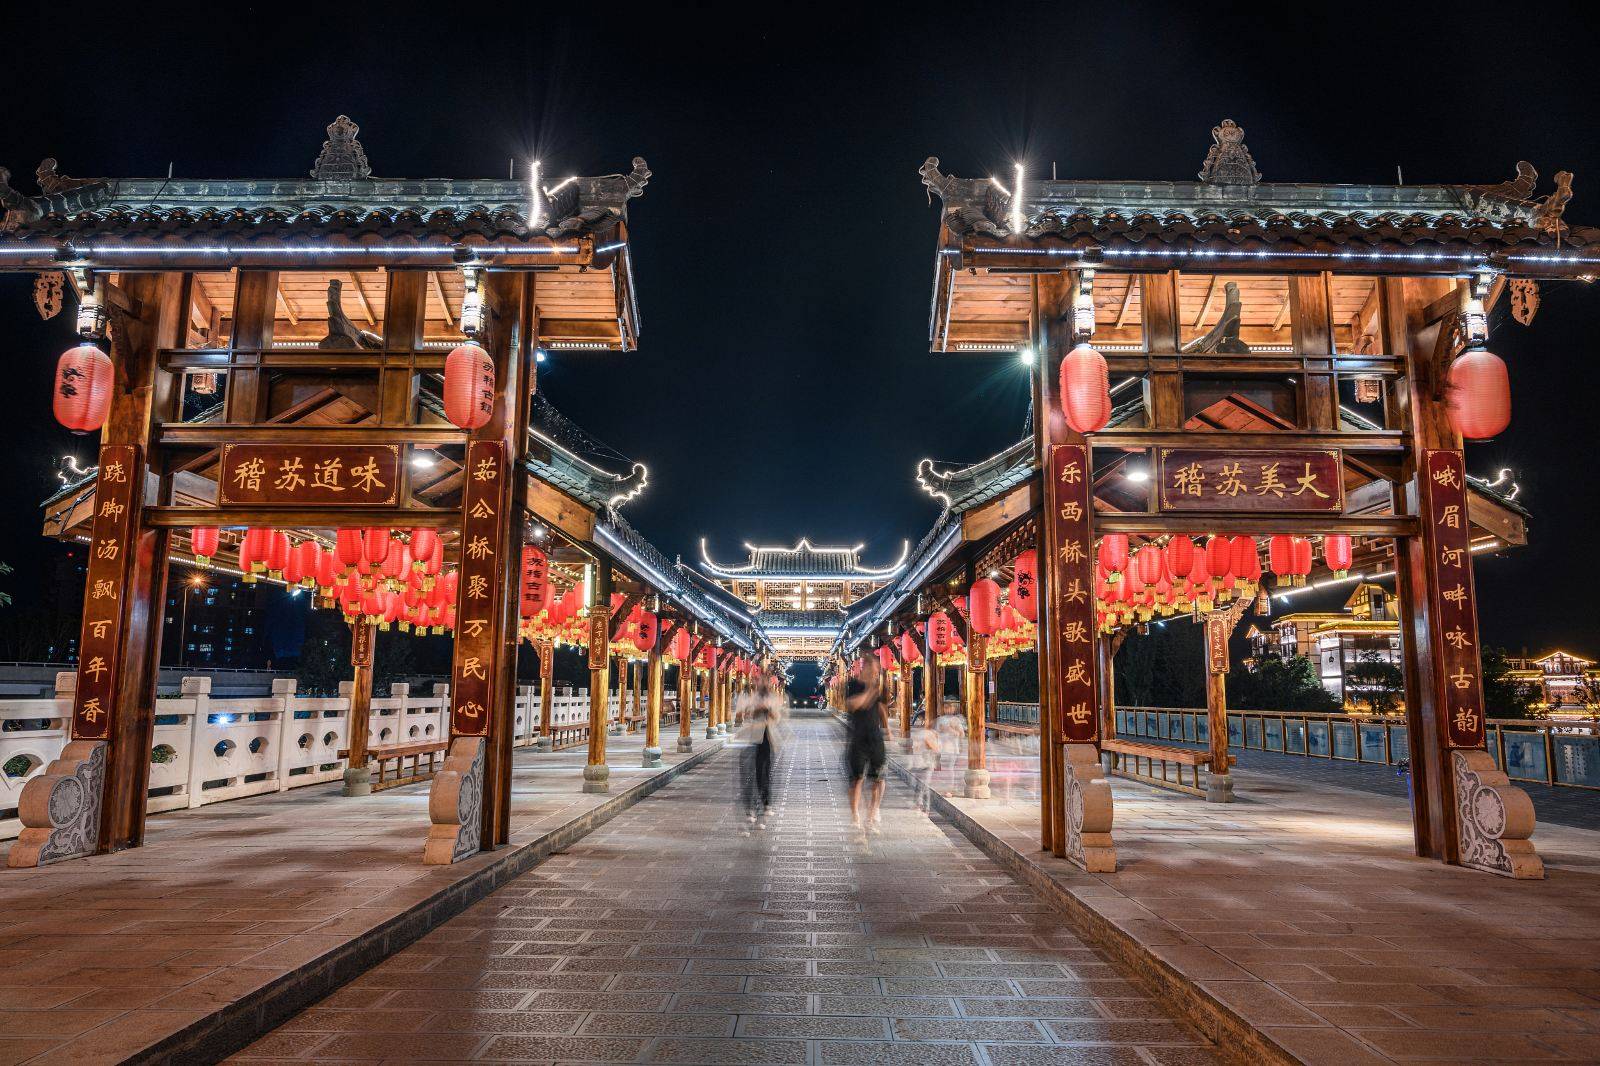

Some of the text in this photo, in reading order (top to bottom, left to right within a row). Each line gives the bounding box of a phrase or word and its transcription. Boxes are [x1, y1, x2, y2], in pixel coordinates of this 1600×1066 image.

[80, 461, 126, 723] 跷脚汤飘百年香
[457, 457, 497, 718] 茹公桥聚万民心
[1060, 461, 1091, 725] 乐西桥头歌盛世
[1432, 465, 1478, 732] 峨眉河畔咏古韵
